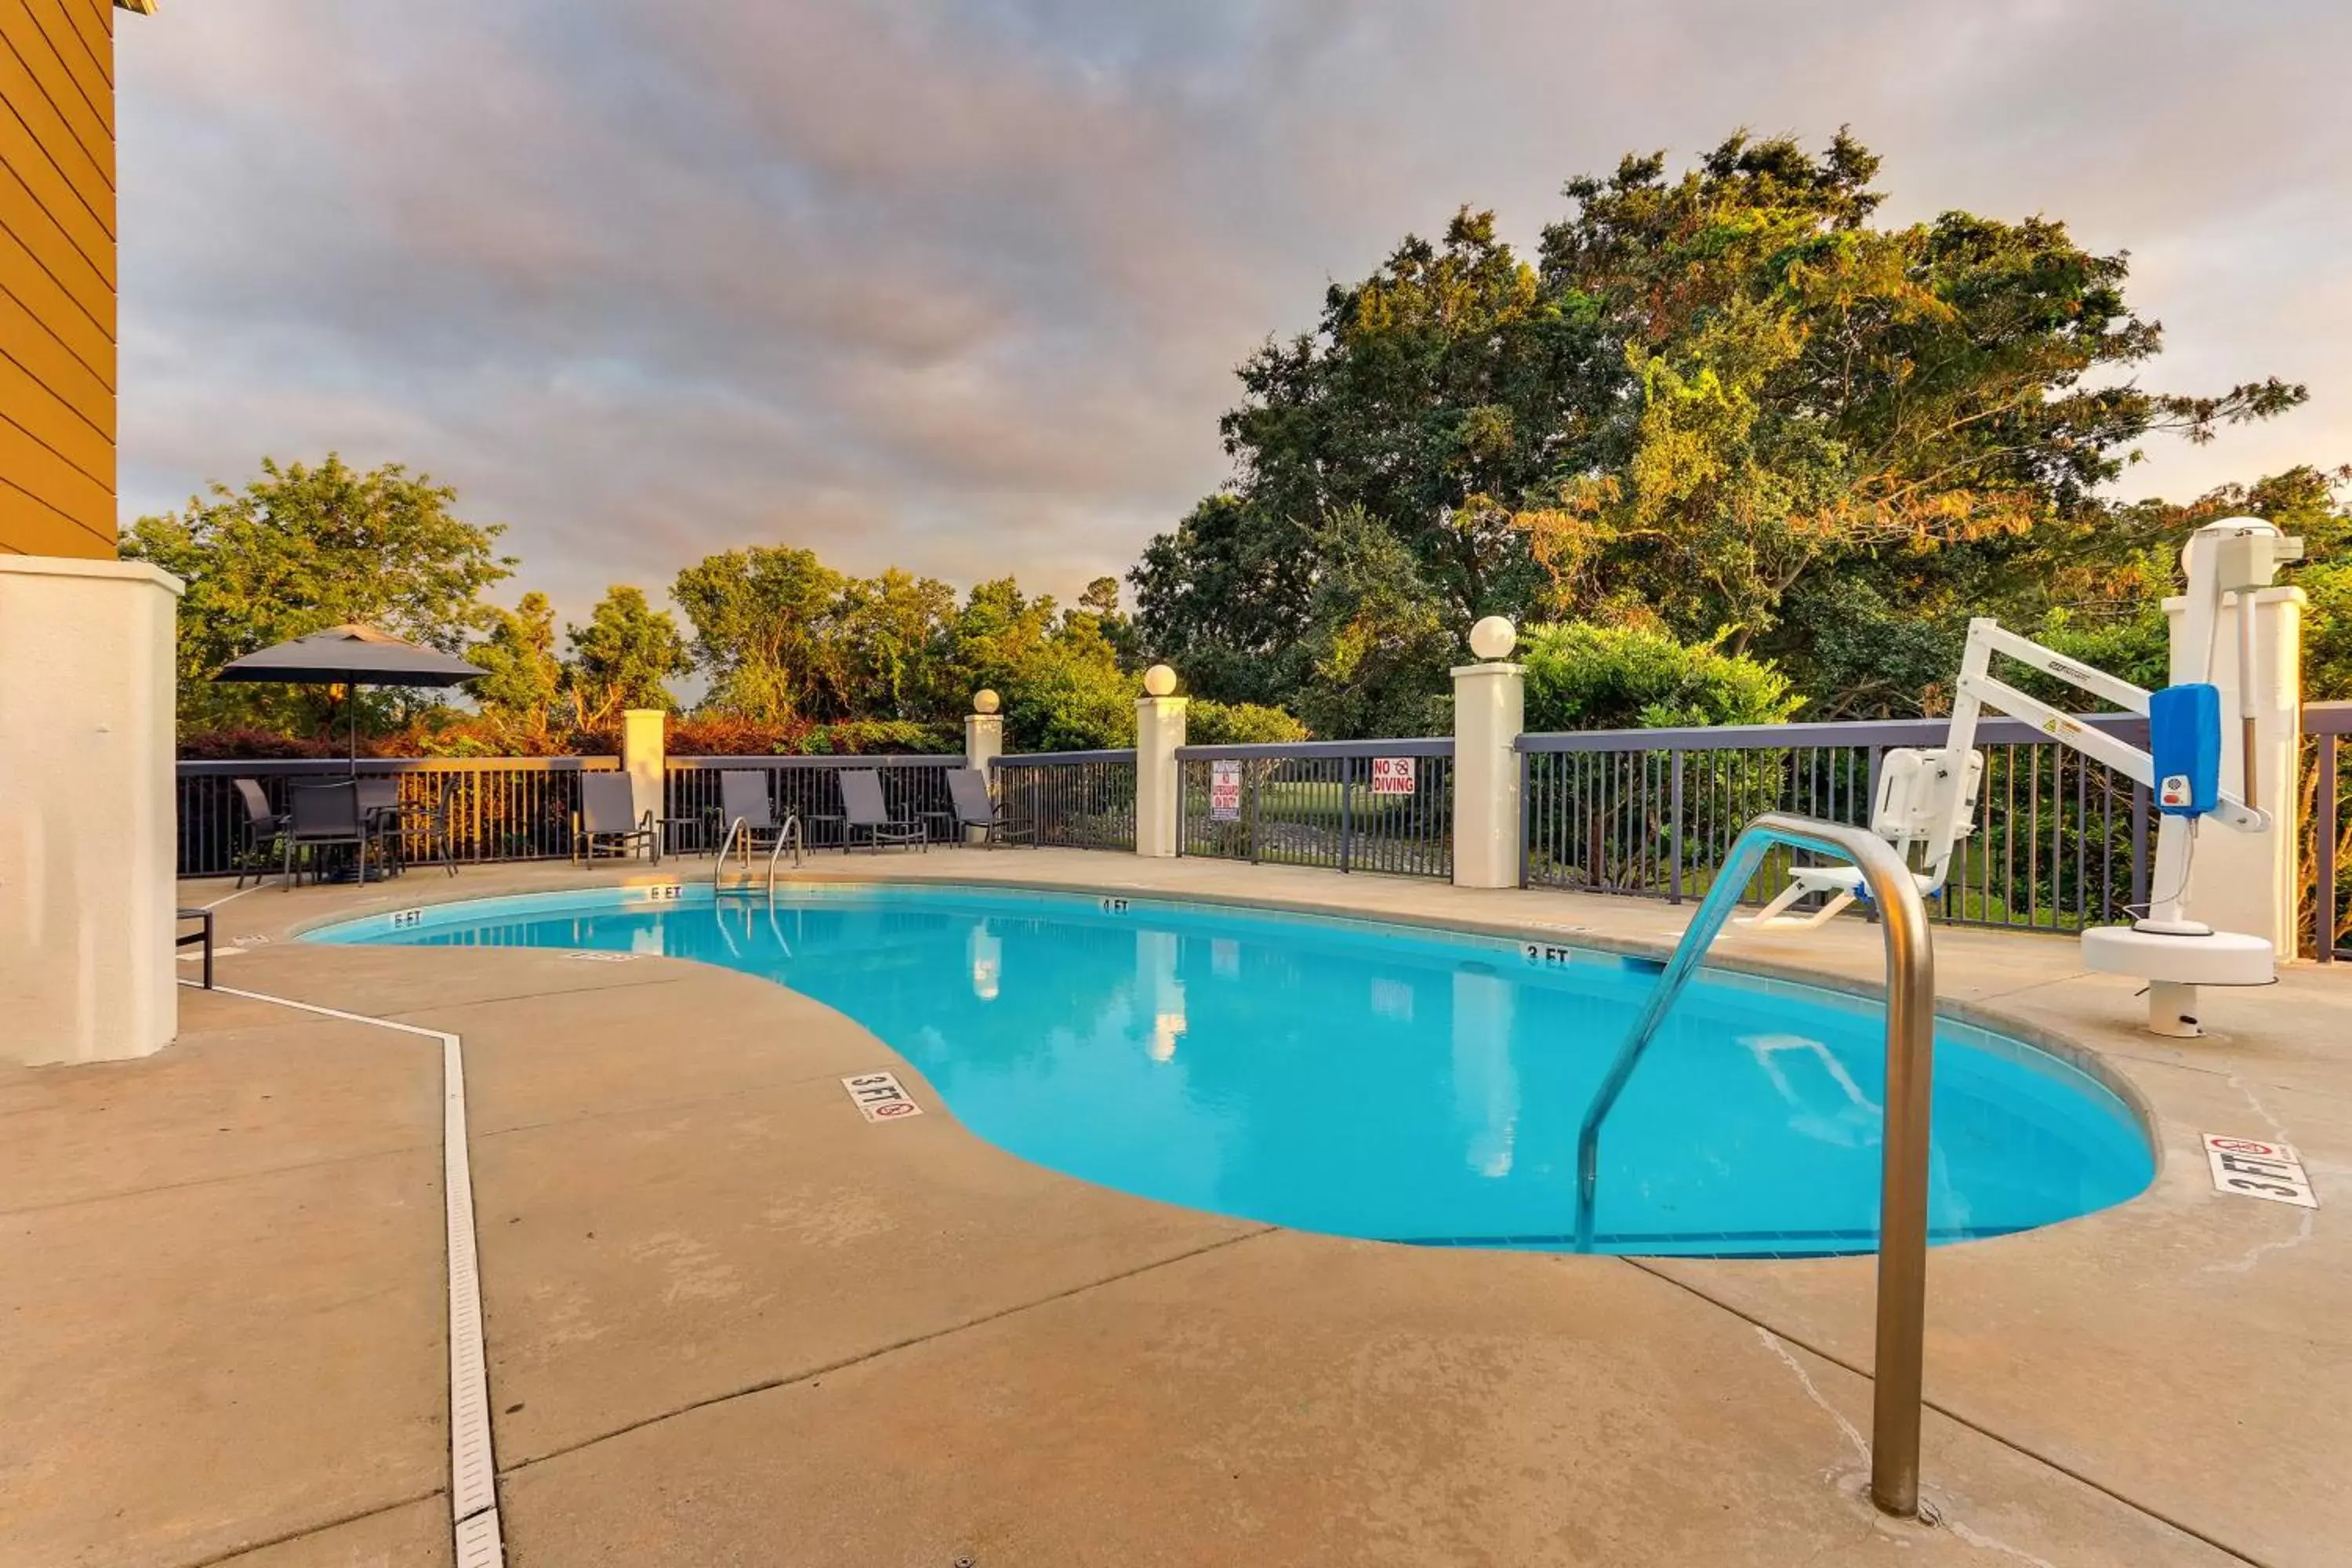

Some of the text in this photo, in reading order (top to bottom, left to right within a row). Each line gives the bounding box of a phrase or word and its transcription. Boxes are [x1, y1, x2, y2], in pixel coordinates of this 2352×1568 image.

[1374, 760, 1389, 775] NO
[1374, 777, 1414, 791] DIVING
[1527, 946, 1538, 961] 3
[851, 1076, 902, 1103] 3 FT
[2220, 1153, 2298, 1197] 3 FT
